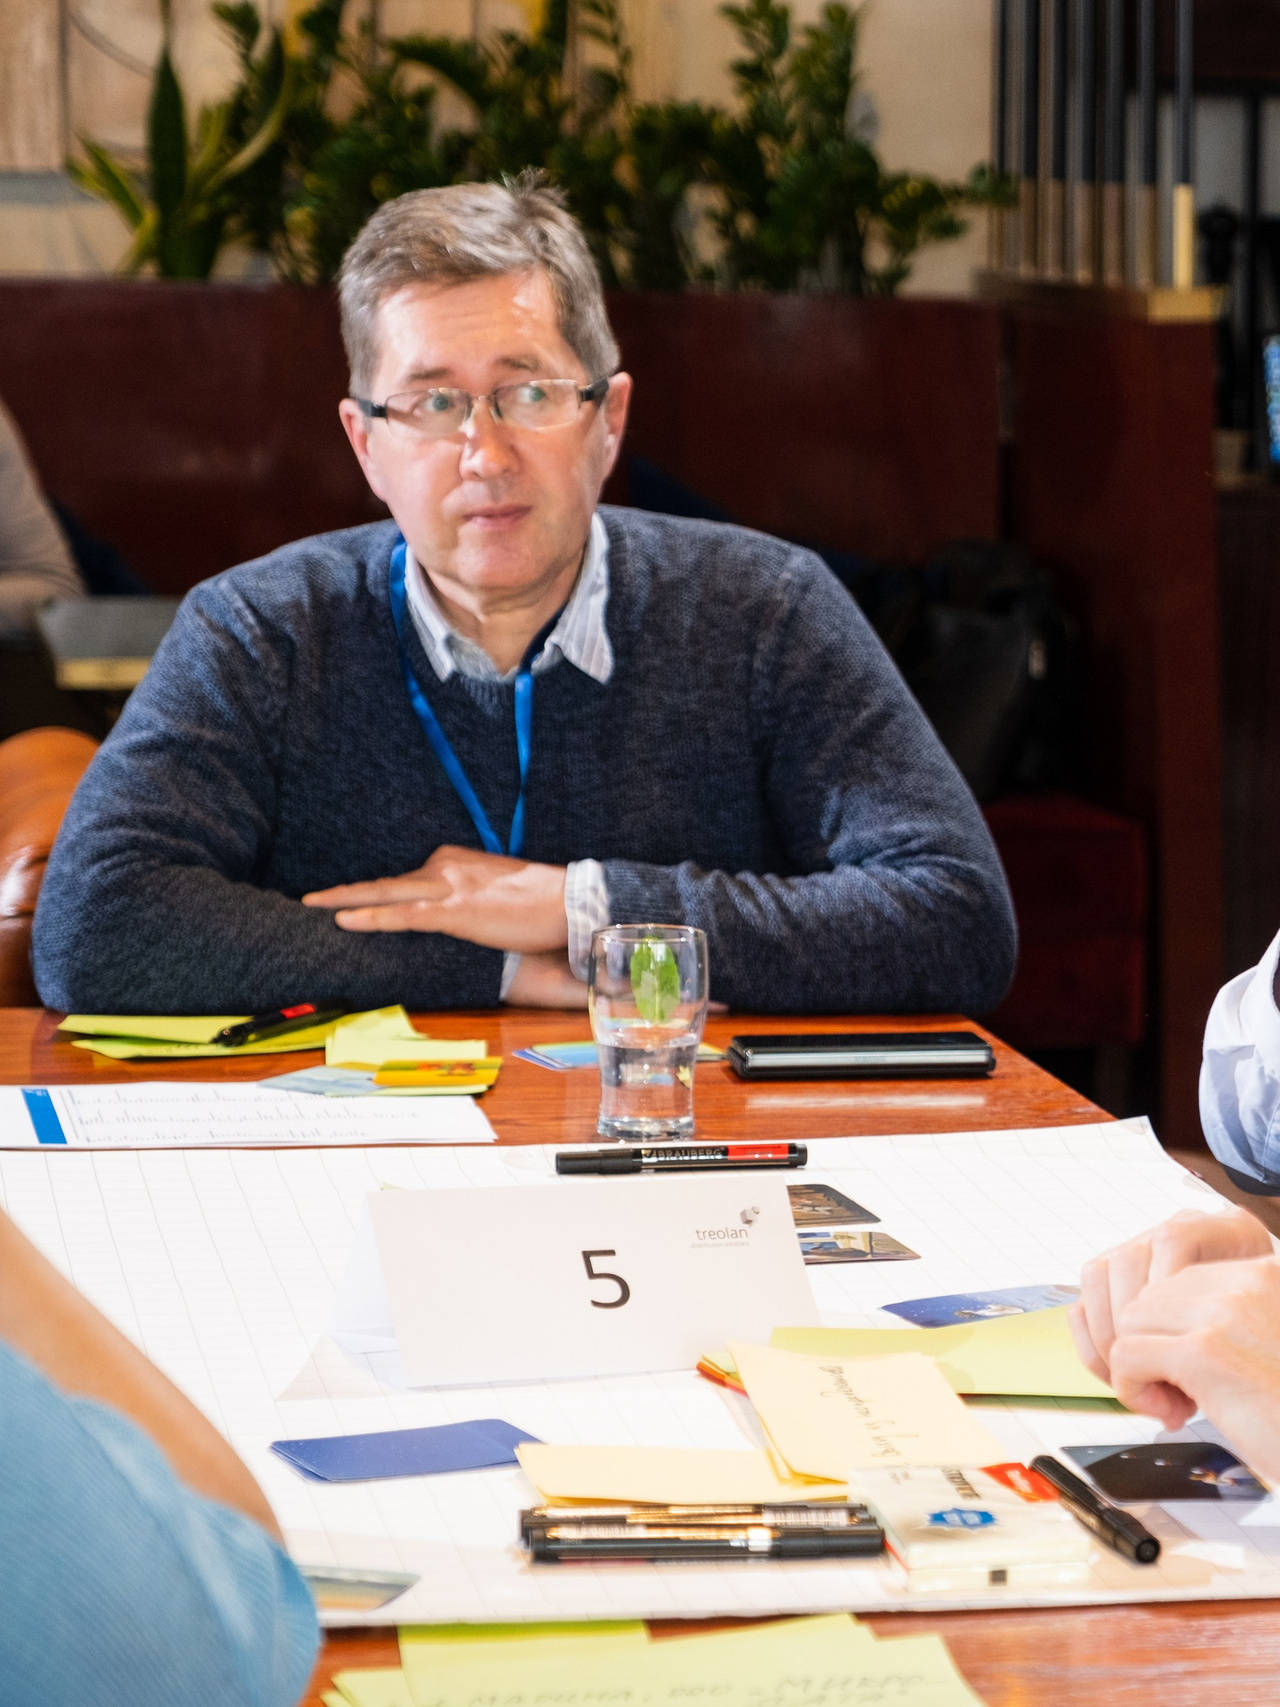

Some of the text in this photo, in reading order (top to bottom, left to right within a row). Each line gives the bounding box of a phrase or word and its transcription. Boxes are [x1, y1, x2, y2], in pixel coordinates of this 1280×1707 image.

[658, 1147, 723, 1161] BRAUBERG
[695, 1227, 749, 1240] treolan
[581, 1249, 631, 1310] 5
